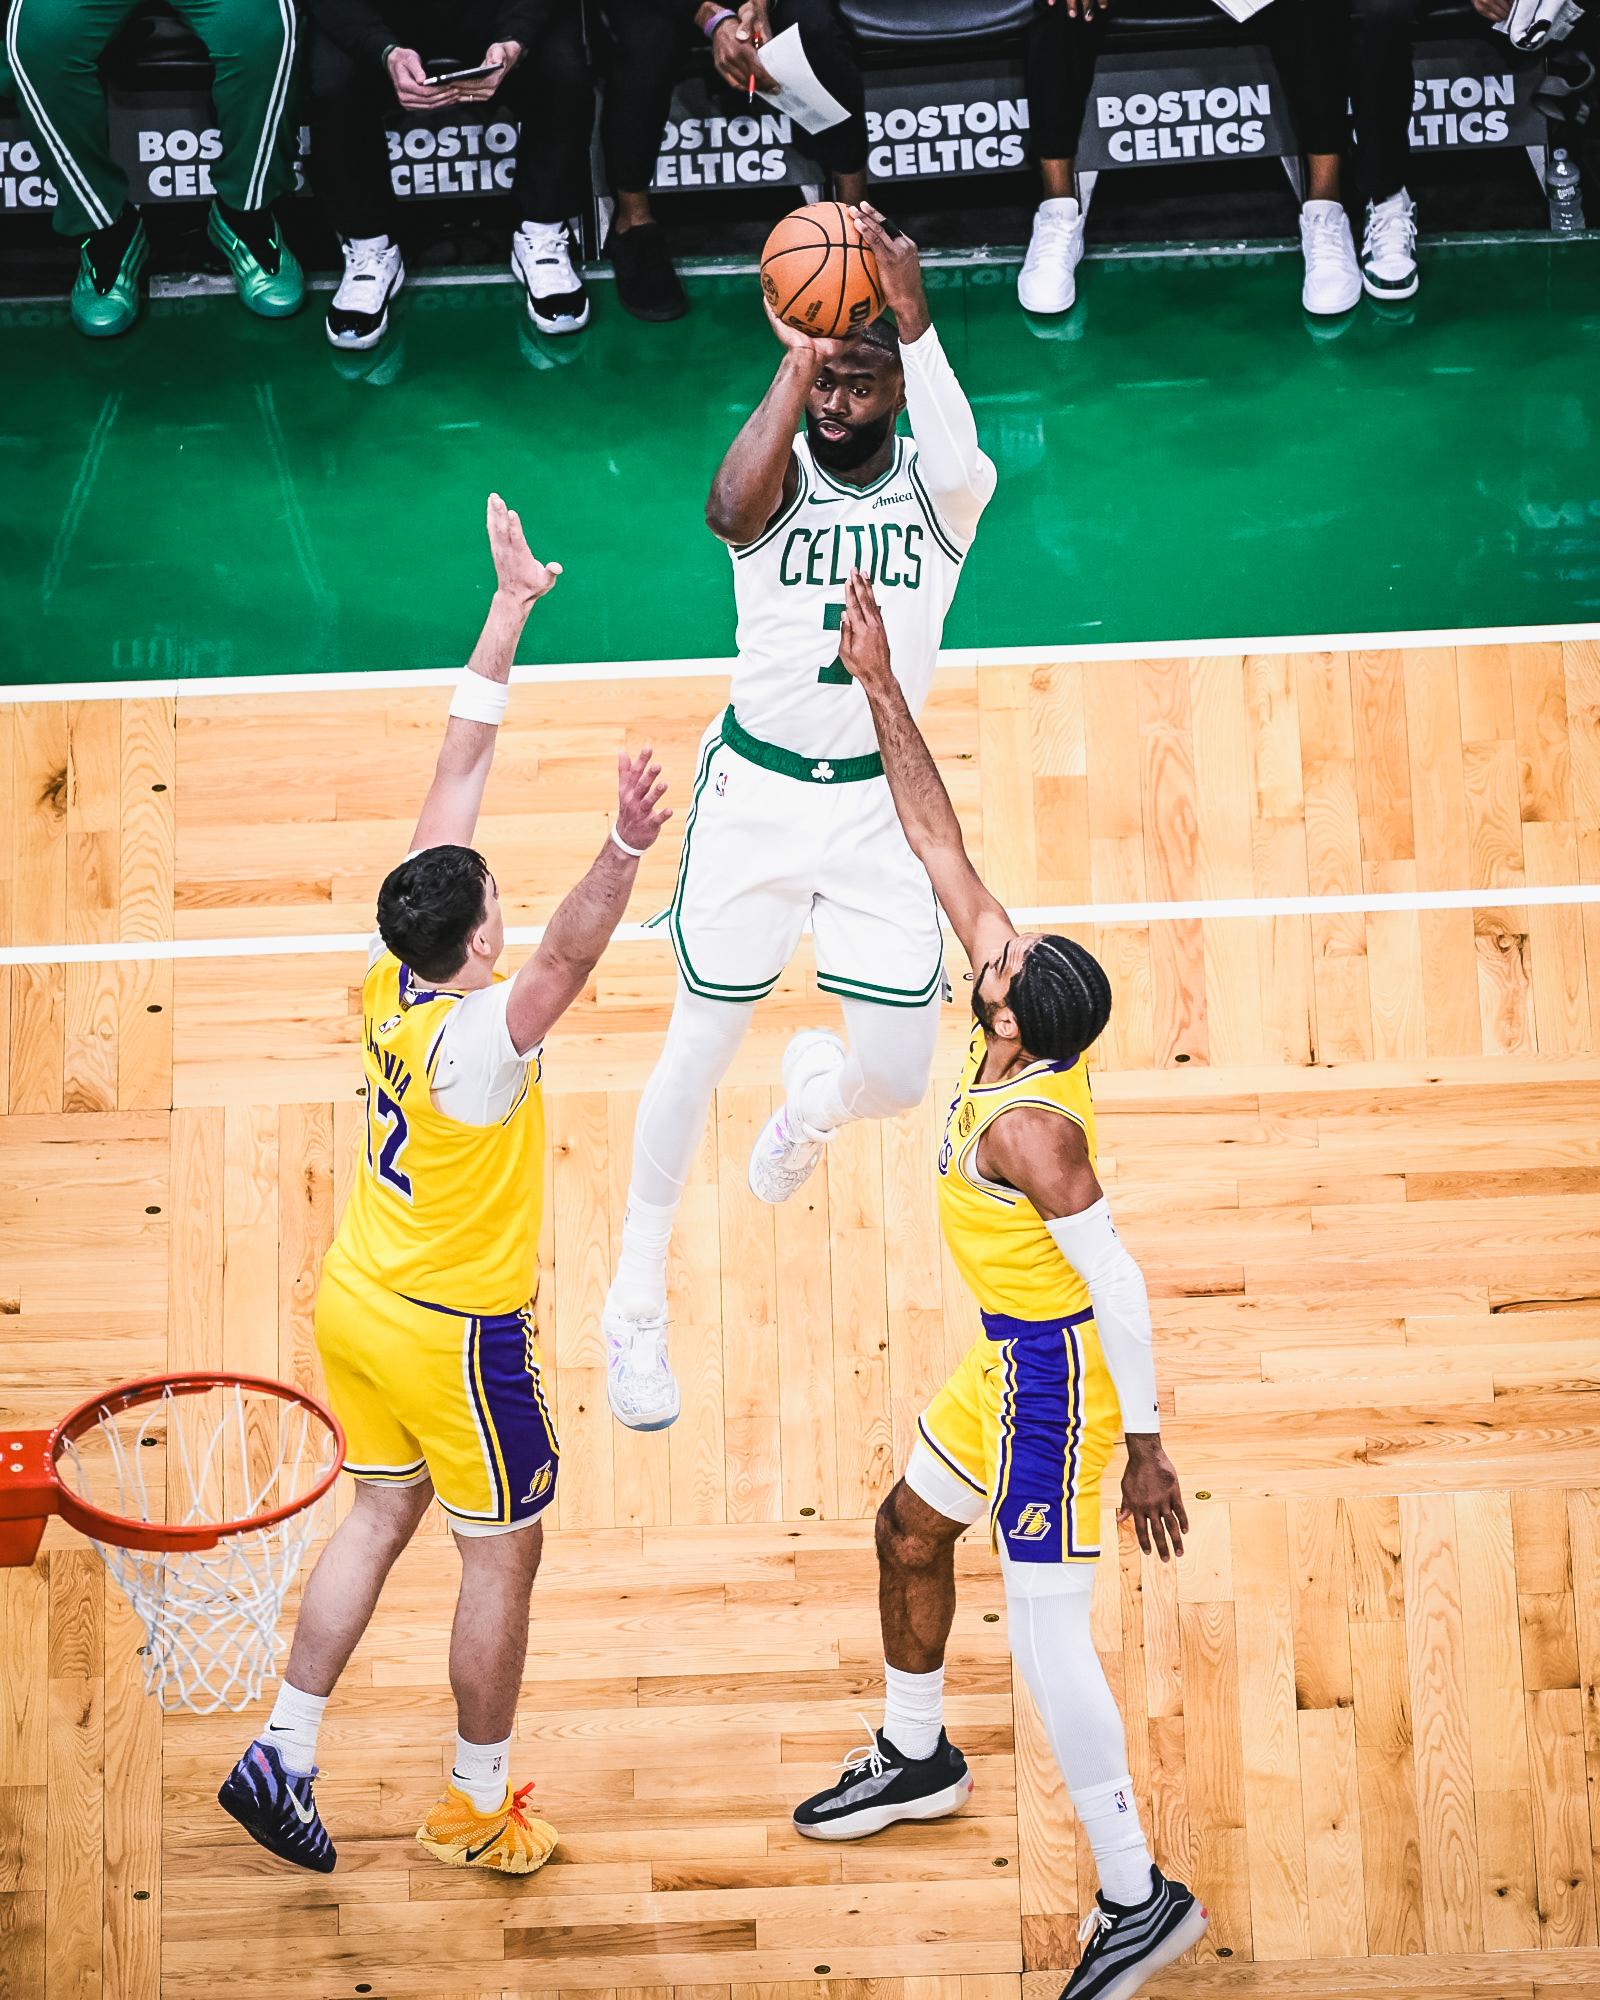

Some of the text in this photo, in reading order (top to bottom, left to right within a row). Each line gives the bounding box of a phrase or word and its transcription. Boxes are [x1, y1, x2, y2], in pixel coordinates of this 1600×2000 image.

[1097, 84, 1271, 128] BOSTON
[1412, 74, 1515, 111] STON
[660, 114, 792, 151] OSTON
[865, 98, 1030, 142] BOSTON
[1408, 110, 1509, 146] LTICS
[385, 121, 522, 161] BOSTO
[868, 134, 1025, 177] CELTICS
[1108, 120, 1266, 162] CELTICS
[391, 158, 516, 196] CELTIC
[649, 149, 787, 186] ELTICS
[872, 492, 914, 510] Amica
[779, 522, 924, 590] CELTICS
